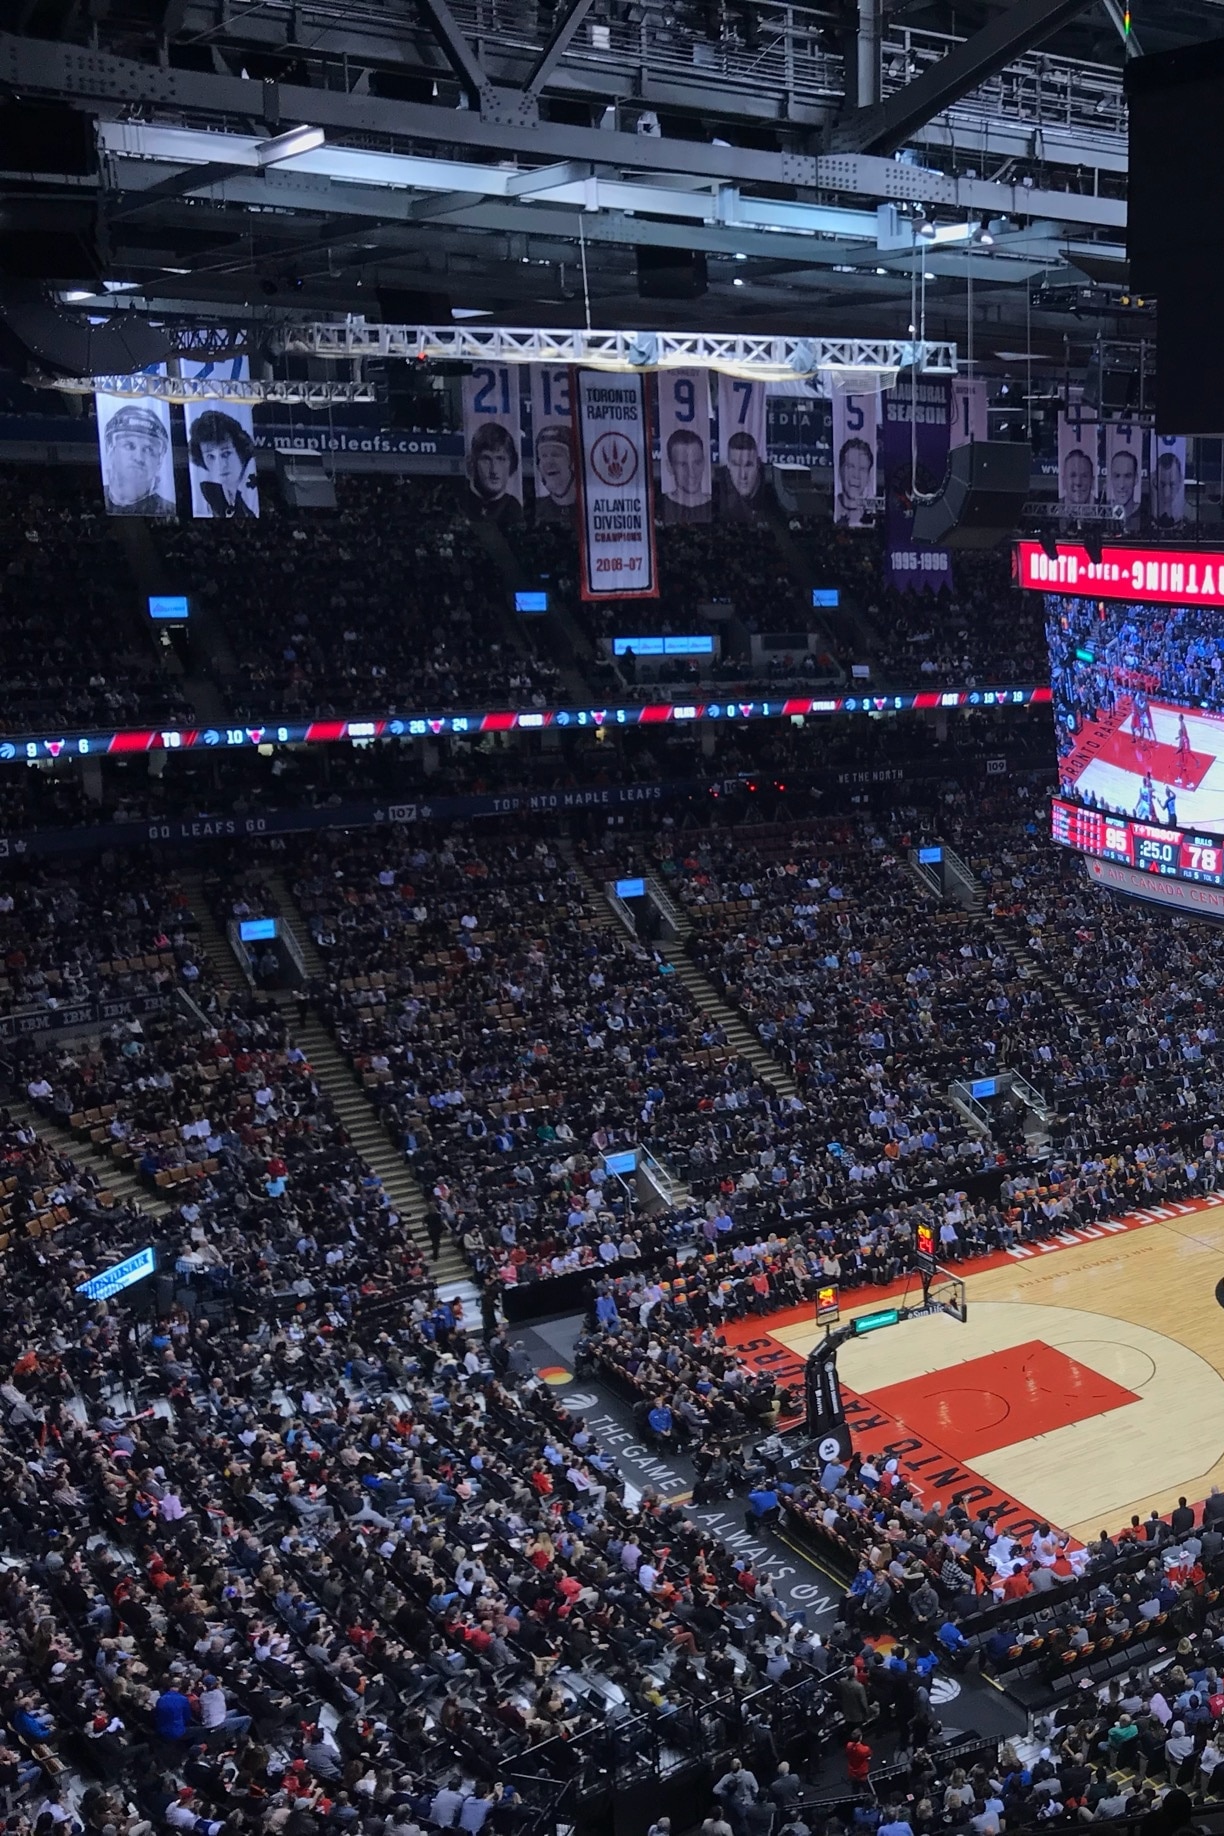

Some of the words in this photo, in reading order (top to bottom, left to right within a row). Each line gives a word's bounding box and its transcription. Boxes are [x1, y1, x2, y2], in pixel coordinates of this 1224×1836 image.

[473, 368, 511, 414] 21
[541, 371, 572, 416] 13
[586, 388, 636, 404] TORONTO
[674, 379, 694, 422] 9
[733, 382, 752, 424] 7
[587, 405, 638, 421] RAPTORS
[847, 396, 863, 431] 5
[887, 404, 947, 424] SEASON
[593, 499, 641, 513] ATLANTIC
[594, 515, 641, 530] DIVISION
[862, 698, 870, 711] 3
[895, 697, 902, 709] 5
[983, 691, 995, 704] 19
[1012, 690, 1024, 702] 19
[577, 711, 586, 725] 3
[616, 709, 625, 723] 5
[727, 704, 735, 718] 0
[762, 702, 769, 716] 1
[409, 720, 426, 734] 26
[451, 717, 468, 732] 24
[161, 731, 181, 747] TO
[226, 730, 243, 744] 10
[853, 771, 870, 783] THE
[873, 769, 904, 781] NORTH
[987, 761, 1006, 773] 109
[493, 796, 558, 811] TORNTO
[564, 790, 609, 806] MAPLE
[620, 787, 662, 801] LEAFS
[390, 807, 416, 820] 107
[149, 826, 171, 839] GO
[181, 820, 236, 837] LEAFS
[245, 818, 267, 833] GO
[1105, 827, 1127, 852] 95
[1194, 836, 1213, 848] BULLS
[1139, 841, 1172, 863] :25.0
[1189, 848, 1217, 872] 78
[1160, 863, 1167, 874] 3
[1107, 868, 1127, 883] AIR
[1130, 874, 1184, 899] CANADA
[20, 1016, 49, 1032] IBM
[63, 1009, 92, 1025] IBM
[103, 1001, 131, 1018] IBM
[1127, 1202, 1196, 1225] THE
[918, 1235, 933, 1253] 24
[1074, 1252, 1132, 1273] CANADA
[1017, 1267, 1070, 1290] CENTRE
[930, 1304, 946, 1316] Life
[589, 1415, 634, 1447] THE
[622, 1444, 688, 1492] GAME
[697, 1512, 797, 1581] ALWAYS
[789, 1583, 840, 1616] ON
